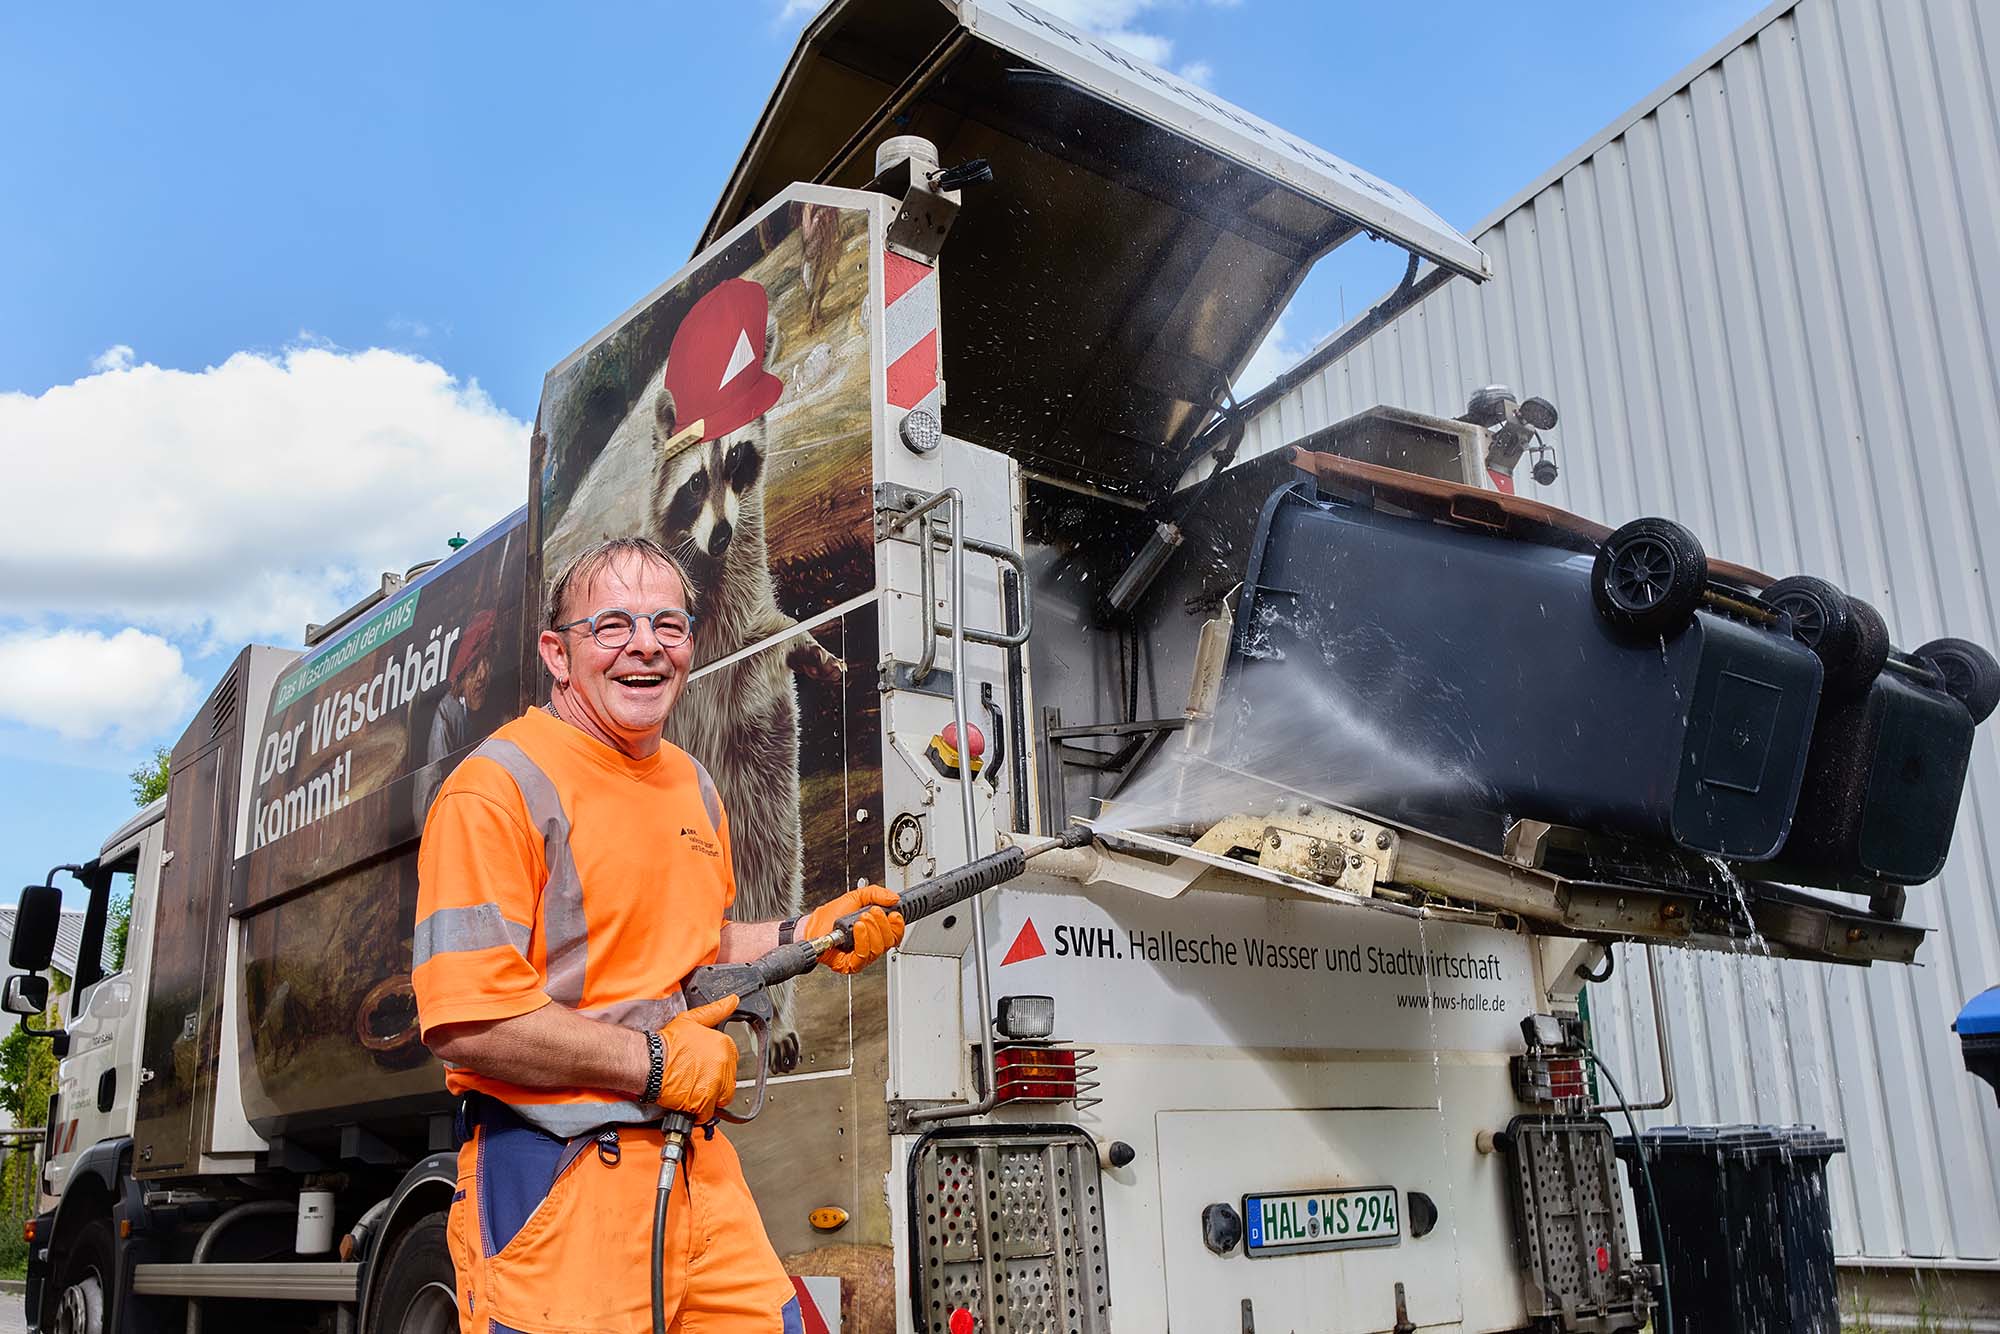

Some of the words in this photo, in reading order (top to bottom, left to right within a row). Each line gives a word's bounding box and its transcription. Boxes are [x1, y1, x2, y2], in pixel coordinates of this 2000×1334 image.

[278, 680, 297, 705] Das
[298, 632, 361, 691] Waschmobil
[360, 623, 382, 650] der
[382, 598, 414, 635] HWS
[259, 718, 305, 786] Der
[311, 624, 460, 755] Waschbär
[253, 750, 352, 850] kommt!
[1054, 924, 1123, 960] SWH.
[1129, 930, 1238, 966] Hallesche
[1244, 936, 1319, 970] Wasser
[1325, 944, 1362, 973] und
[1367, 946, 1502, 981] Stadtwirtschaft
[1397, 992, 1506, 1012] wwwhws-halle.de
[1263, 1202, 1306, 1241] HAL
[1322, 1197, 1350, 1235] WS
[1354, 1195, 1395, 1232] 294
